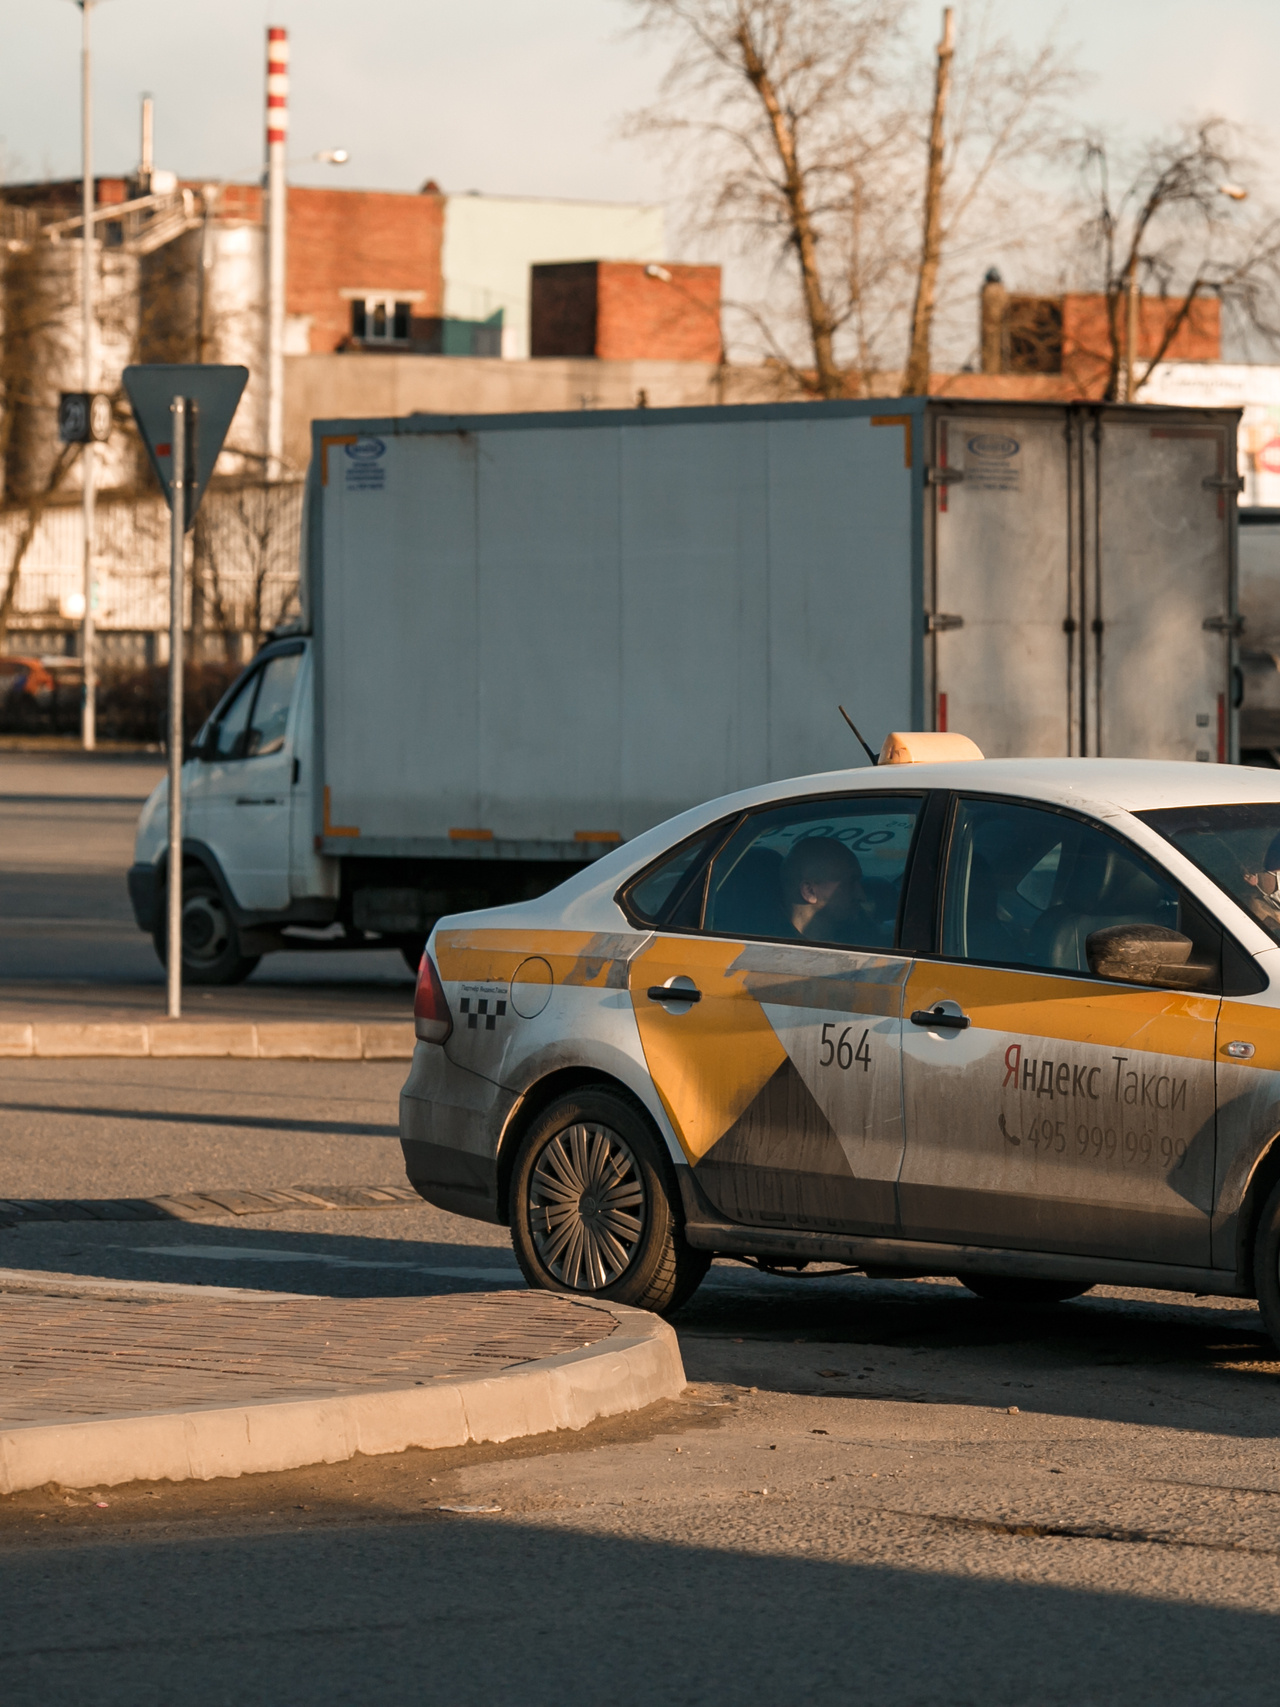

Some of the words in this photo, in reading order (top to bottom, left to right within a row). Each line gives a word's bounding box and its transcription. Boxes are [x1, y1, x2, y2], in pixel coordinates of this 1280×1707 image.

[819, 1022, 872, 1072] 564
[1002, 1043, 1102, 1100] Яндекс
[1112, 1056, 1187, 1112] Такси
[1027, 1117, 1067, 1153] 495
[1076, 1124, 1118, 1160] 999
[1125, 1131, 1152, 1164] 99
[1160, 1135, 1188, 1169] 99
